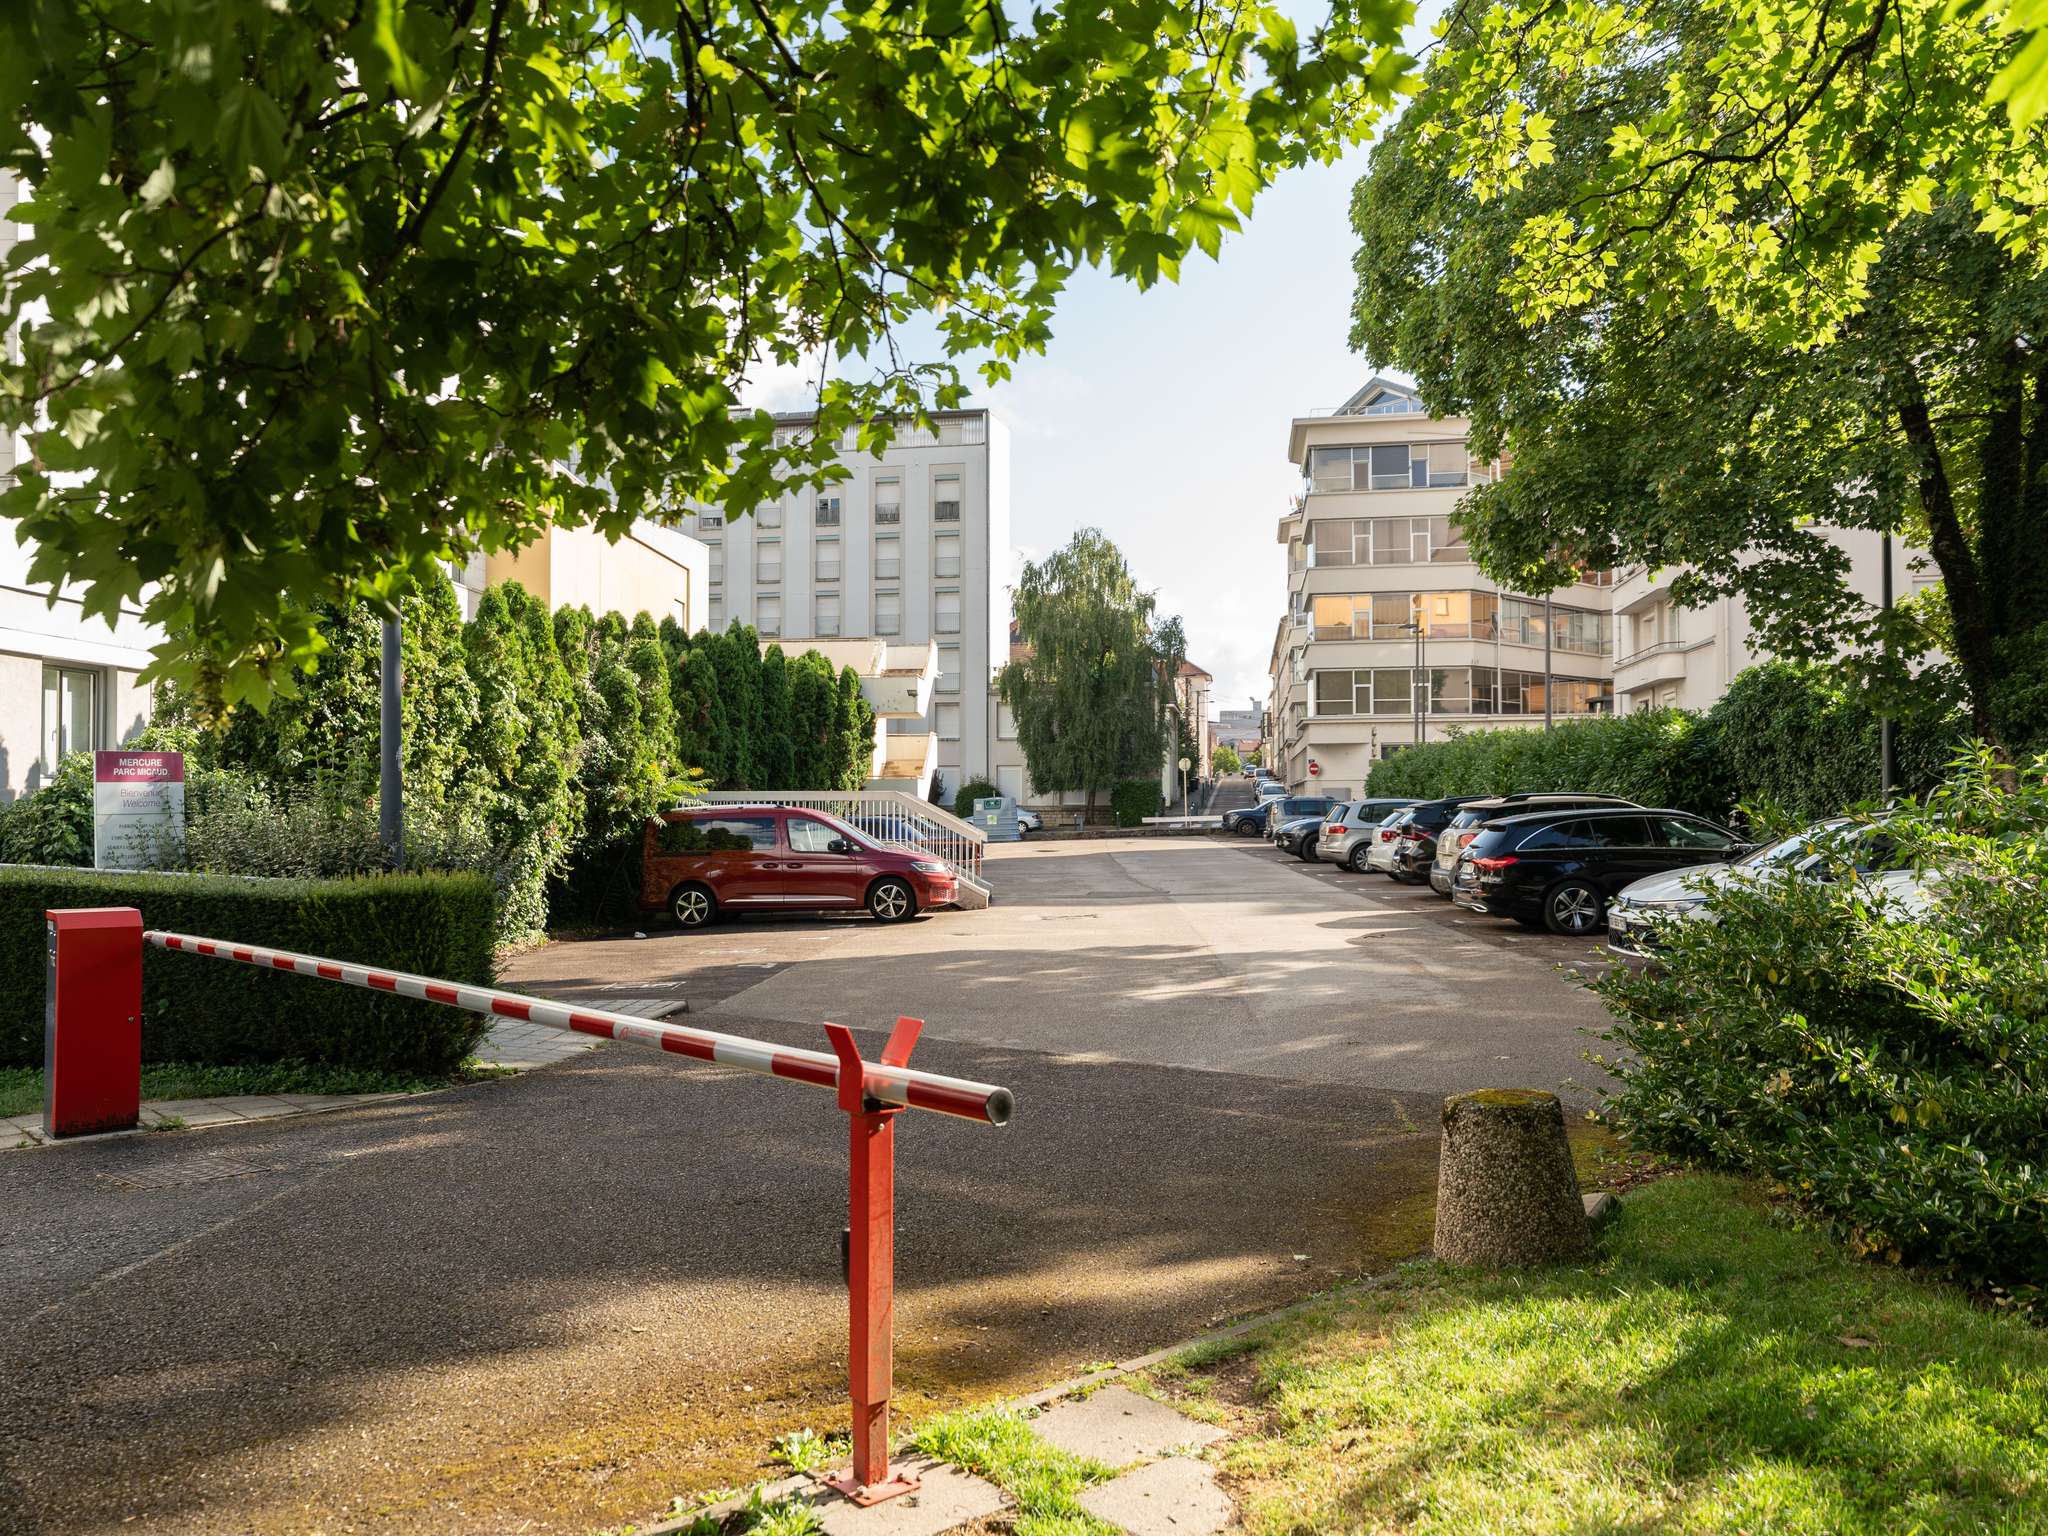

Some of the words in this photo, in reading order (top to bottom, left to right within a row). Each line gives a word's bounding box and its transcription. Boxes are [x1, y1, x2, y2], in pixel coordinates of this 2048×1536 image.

[119, 758, 162, 767] MERCURE
[113, 768, 136, 776] PARC
[137, 768, 168, 776] MICAUD
[123, 799, 161, 808] Welcome
